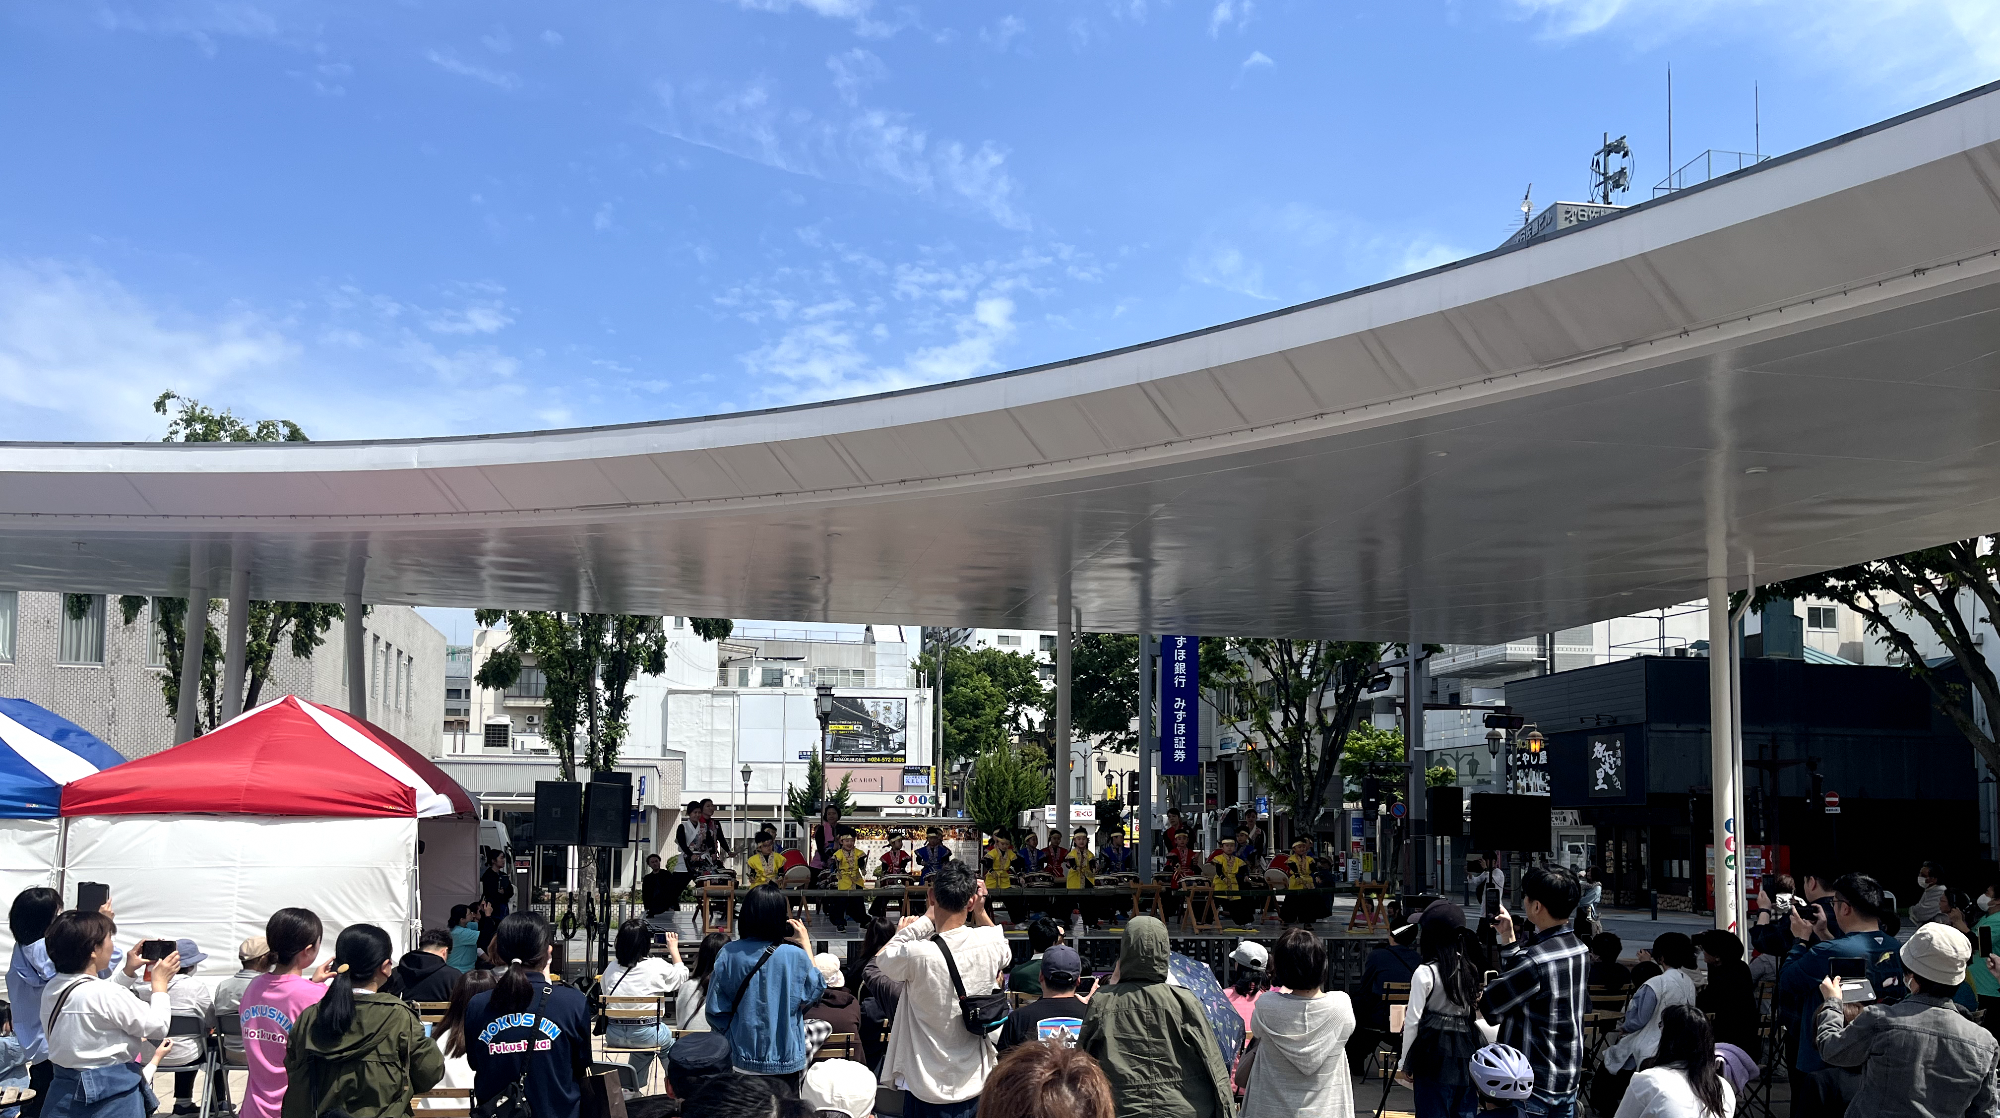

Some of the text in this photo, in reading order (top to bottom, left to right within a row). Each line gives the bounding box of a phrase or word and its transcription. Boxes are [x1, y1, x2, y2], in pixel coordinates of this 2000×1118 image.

[1173, 697, 1187, 762] みずほ証券
[1074, 810, 1093, 818] 宝くじ
[243, 1026, 287, 1044] Hoikuen
